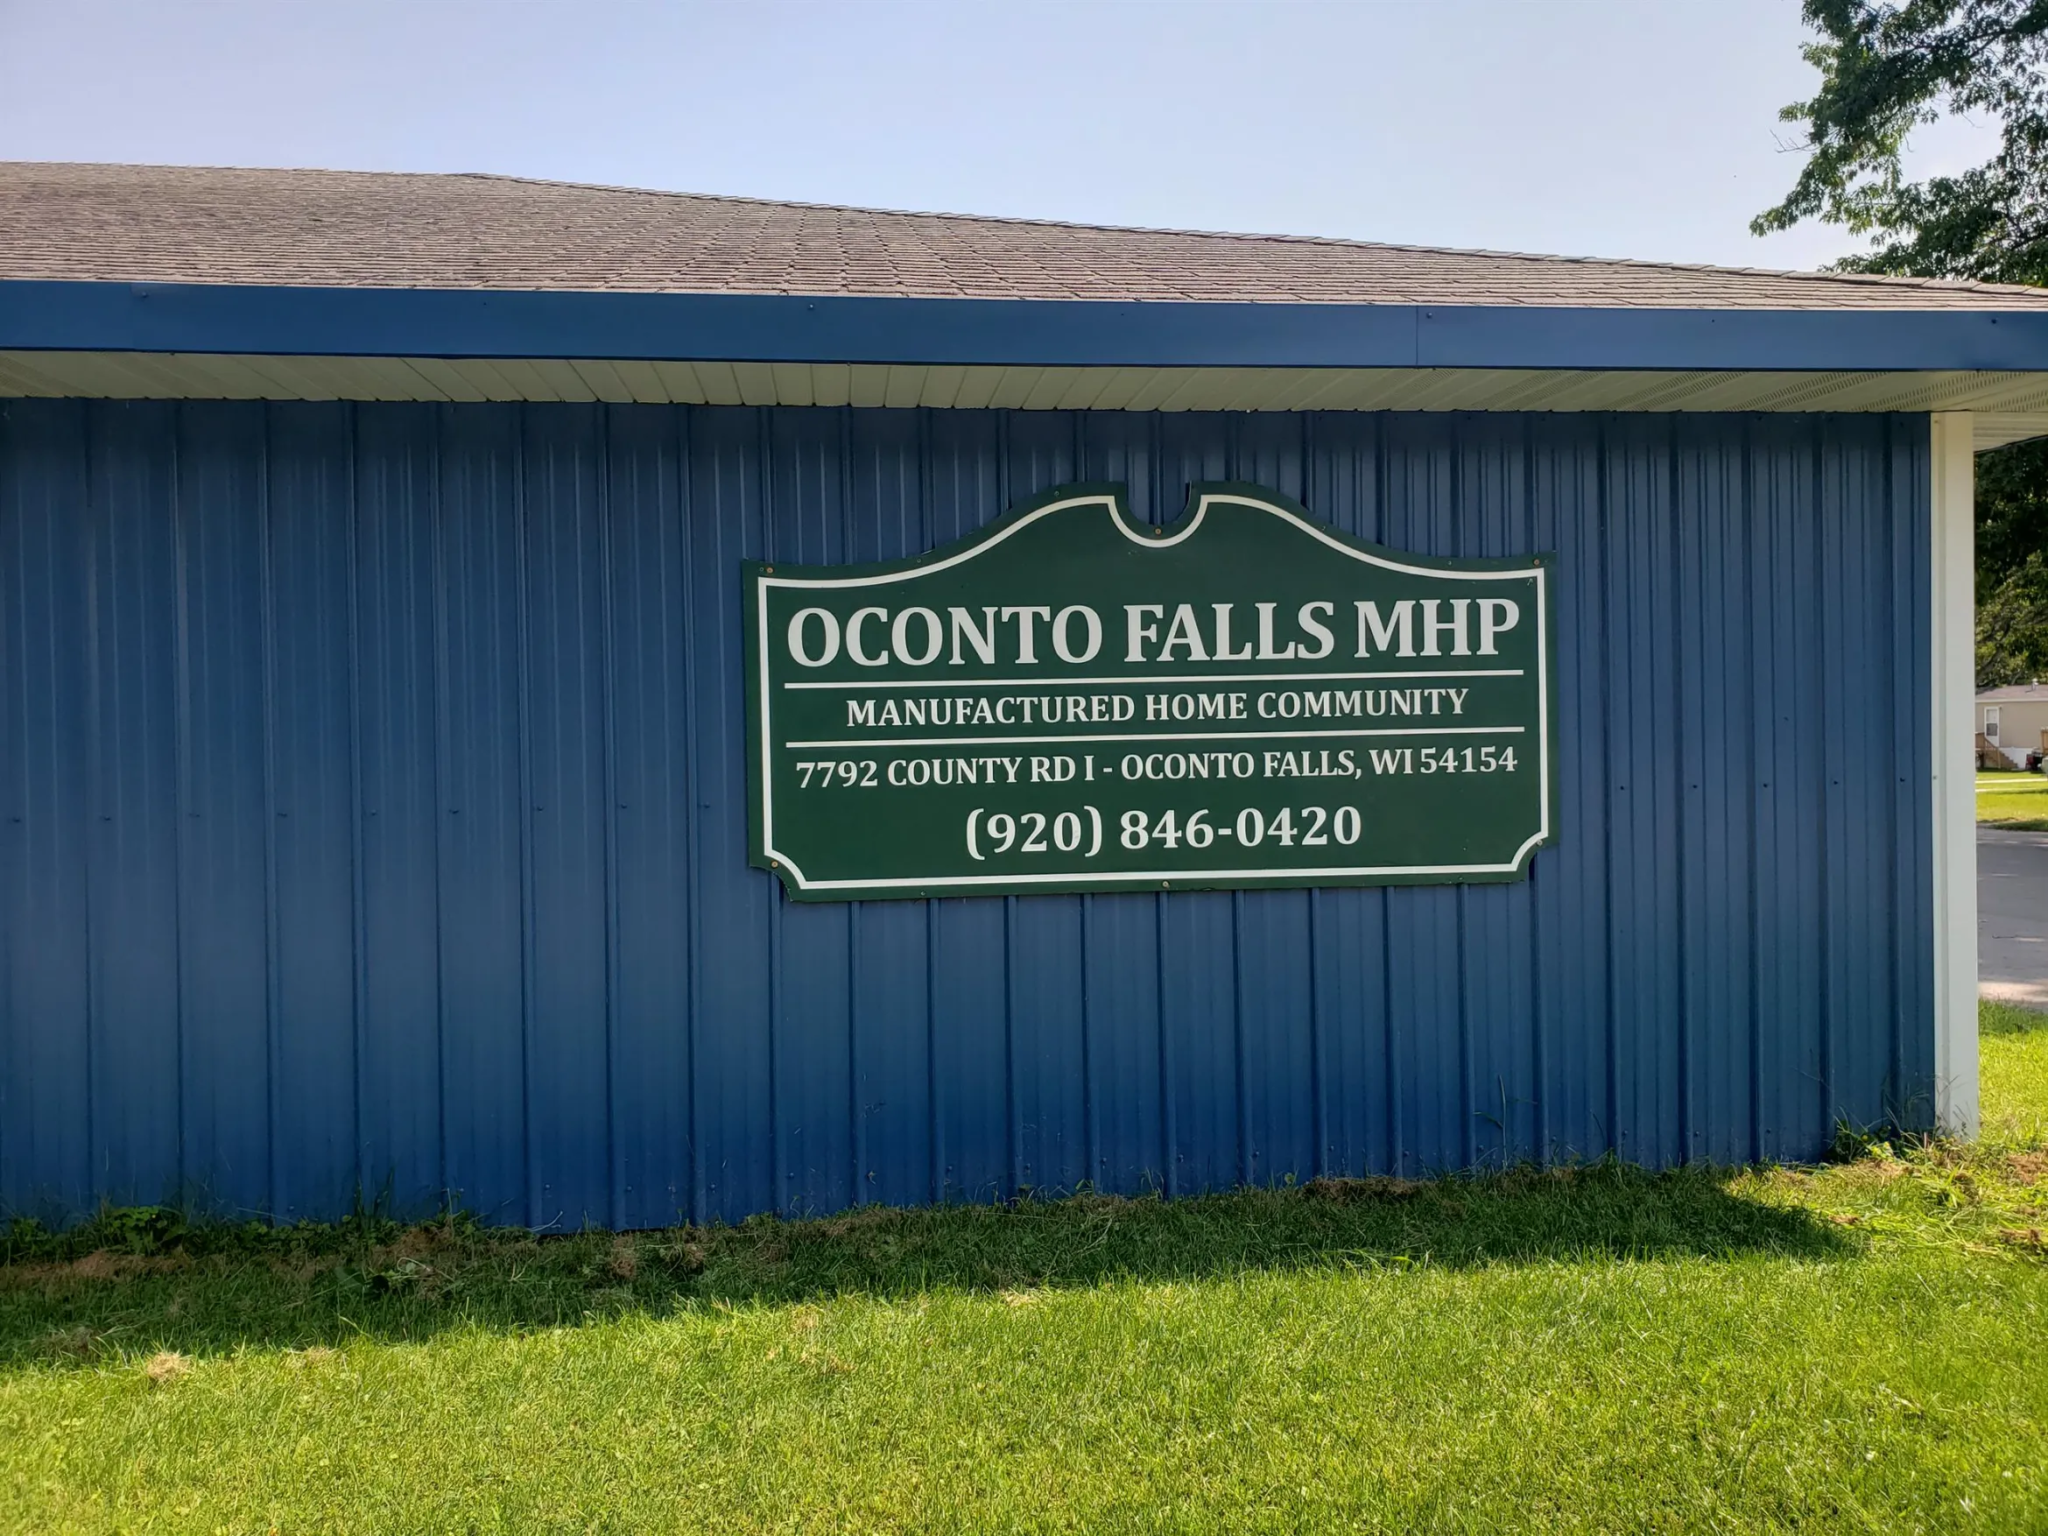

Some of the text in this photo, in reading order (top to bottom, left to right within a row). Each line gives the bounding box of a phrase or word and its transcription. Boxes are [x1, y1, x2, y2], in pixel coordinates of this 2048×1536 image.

[787, 598, 1520, 667] OCONTO FALLS MHP
[846, 688, 1469, 727] MANUFACTURED HOME COMMUNITY
[796, 760, 878, 789] 7792
[887, 756, 1023, 786] COUNTY
[1029, 756, 1076, 783] RD
[1084, 755, 1095, 781] I
[1121, 752, 1255, 780] OCONTO
[1263, 749, 1362, 780] FALLS,
[1368, 748, 1414, 775] WI
[1420, 745, 1518, 774] 54154
[966, 805, 1362, 861] (920) 846-0420
